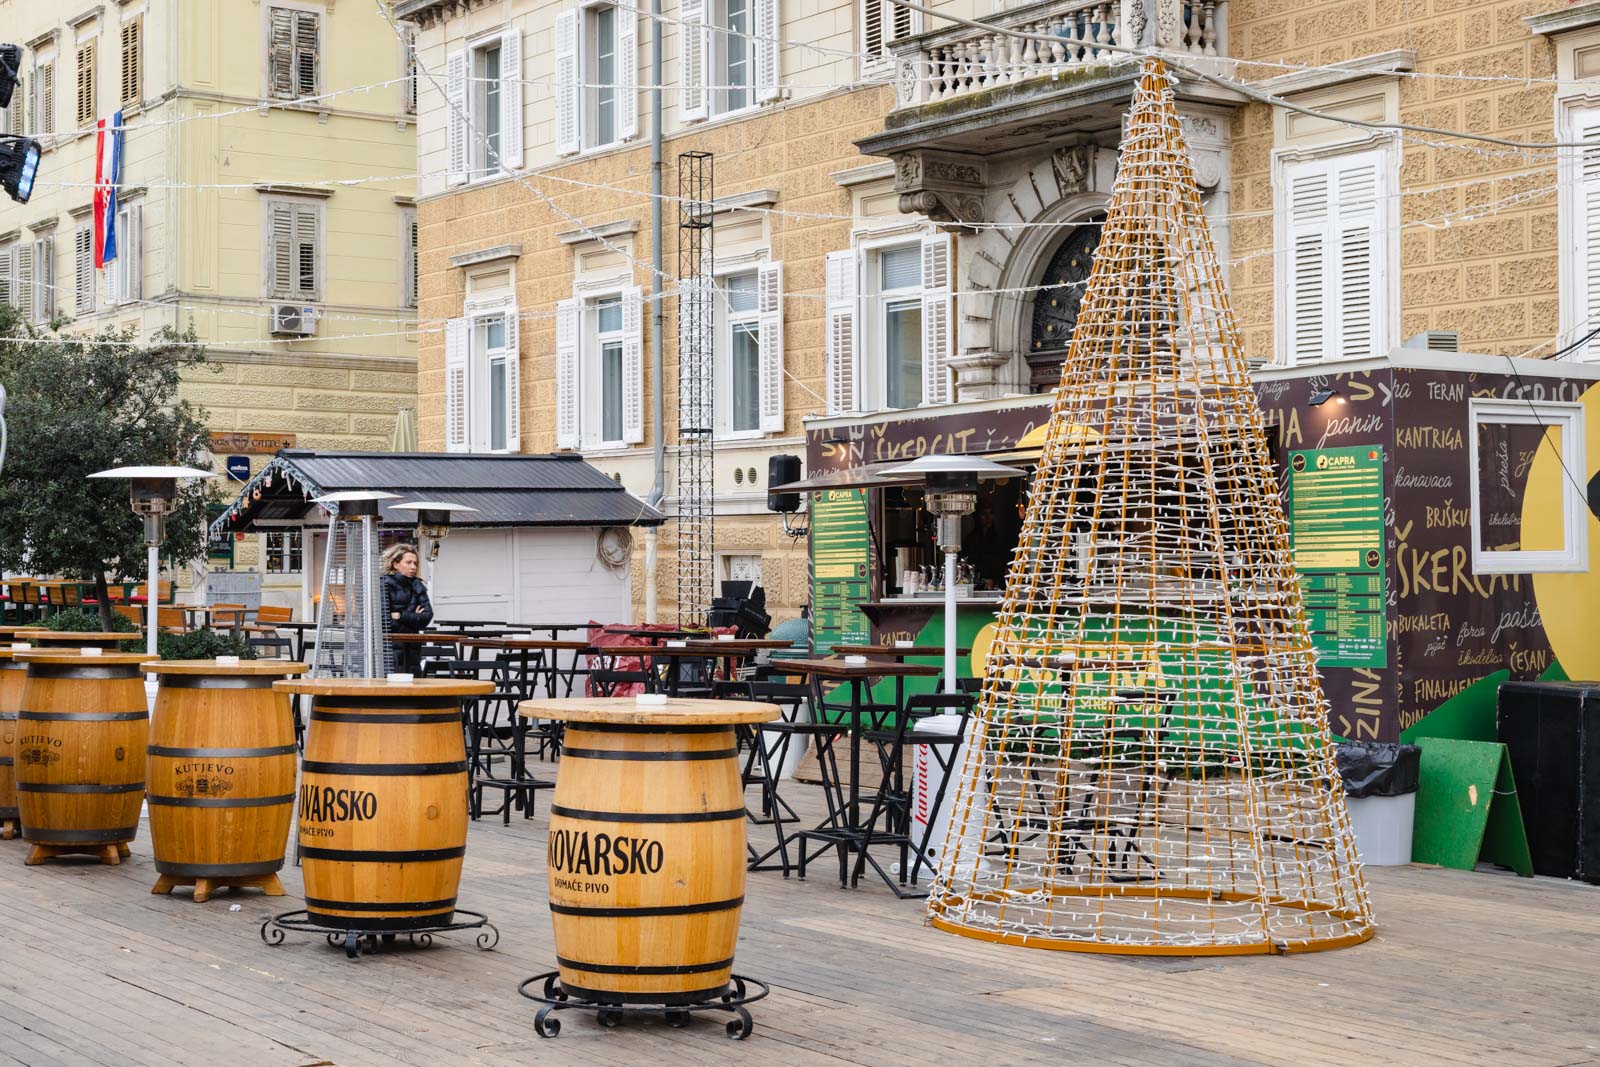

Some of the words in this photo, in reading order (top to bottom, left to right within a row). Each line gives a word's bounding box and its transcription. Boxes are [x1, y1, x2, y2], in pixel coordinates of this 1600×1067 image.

[1427, 382, 1464, 402] TERAN
[1396, 426, 1463, 450] KANTRIGA
[1328, 455, 1356, 466] CAPRA
[1394, 466, 1453, 489] kanavaca
[1398, 612, 1450, 634] BUKALETA
[1509, 642, 1546, 673] ČESAN
[1414, 676, 1485, 704] FINALMEN
[175, 763, 234, 776] KUTJEVO
[914, 744, 929, 827] Jamnica
[317, 828, 334, 838] PIVO
[585, 882, 609, 894] PIVO
